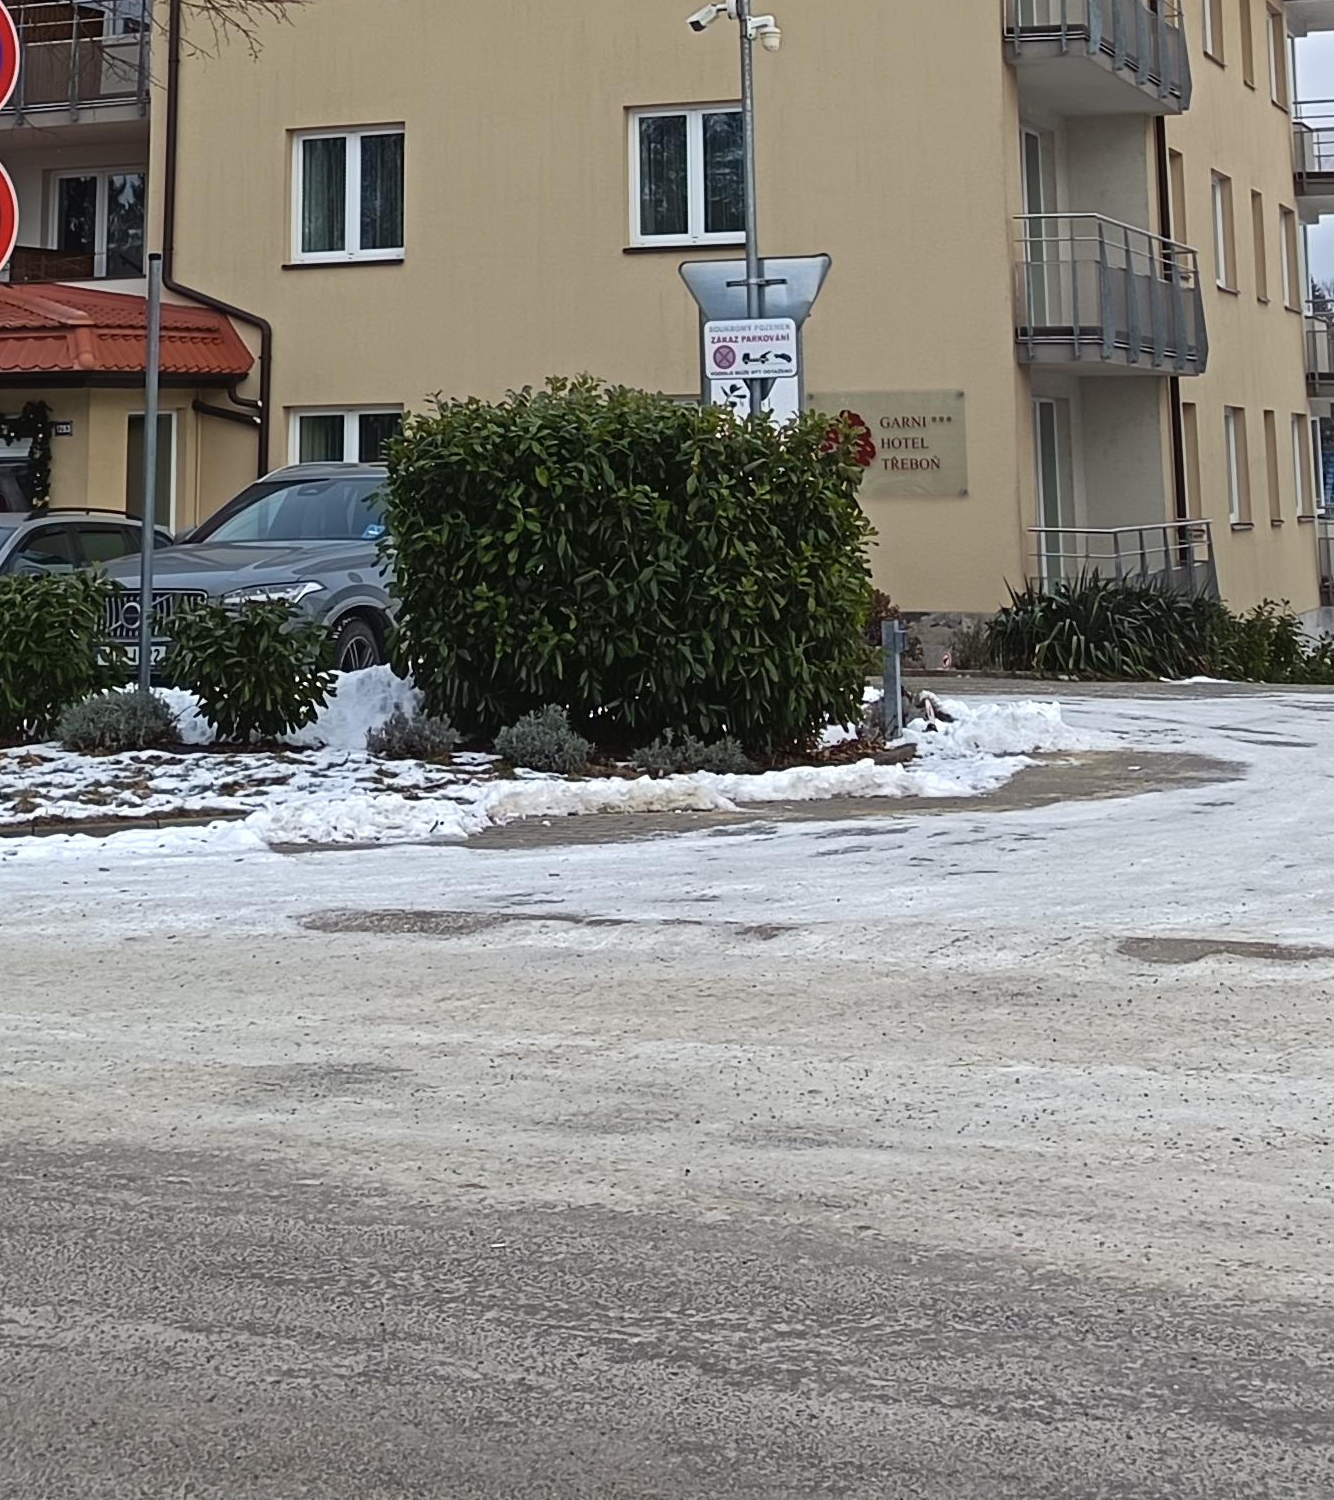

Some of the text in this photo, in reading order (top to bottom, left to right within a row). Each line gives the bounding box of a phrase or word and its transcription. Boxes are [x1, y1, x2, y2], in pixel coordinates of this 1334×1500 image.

[880, 416, 926, 429] GARNI
[881, 437, 929, 450] HOTEL
[881, 455, 941, 470] TŘEBOŇ
